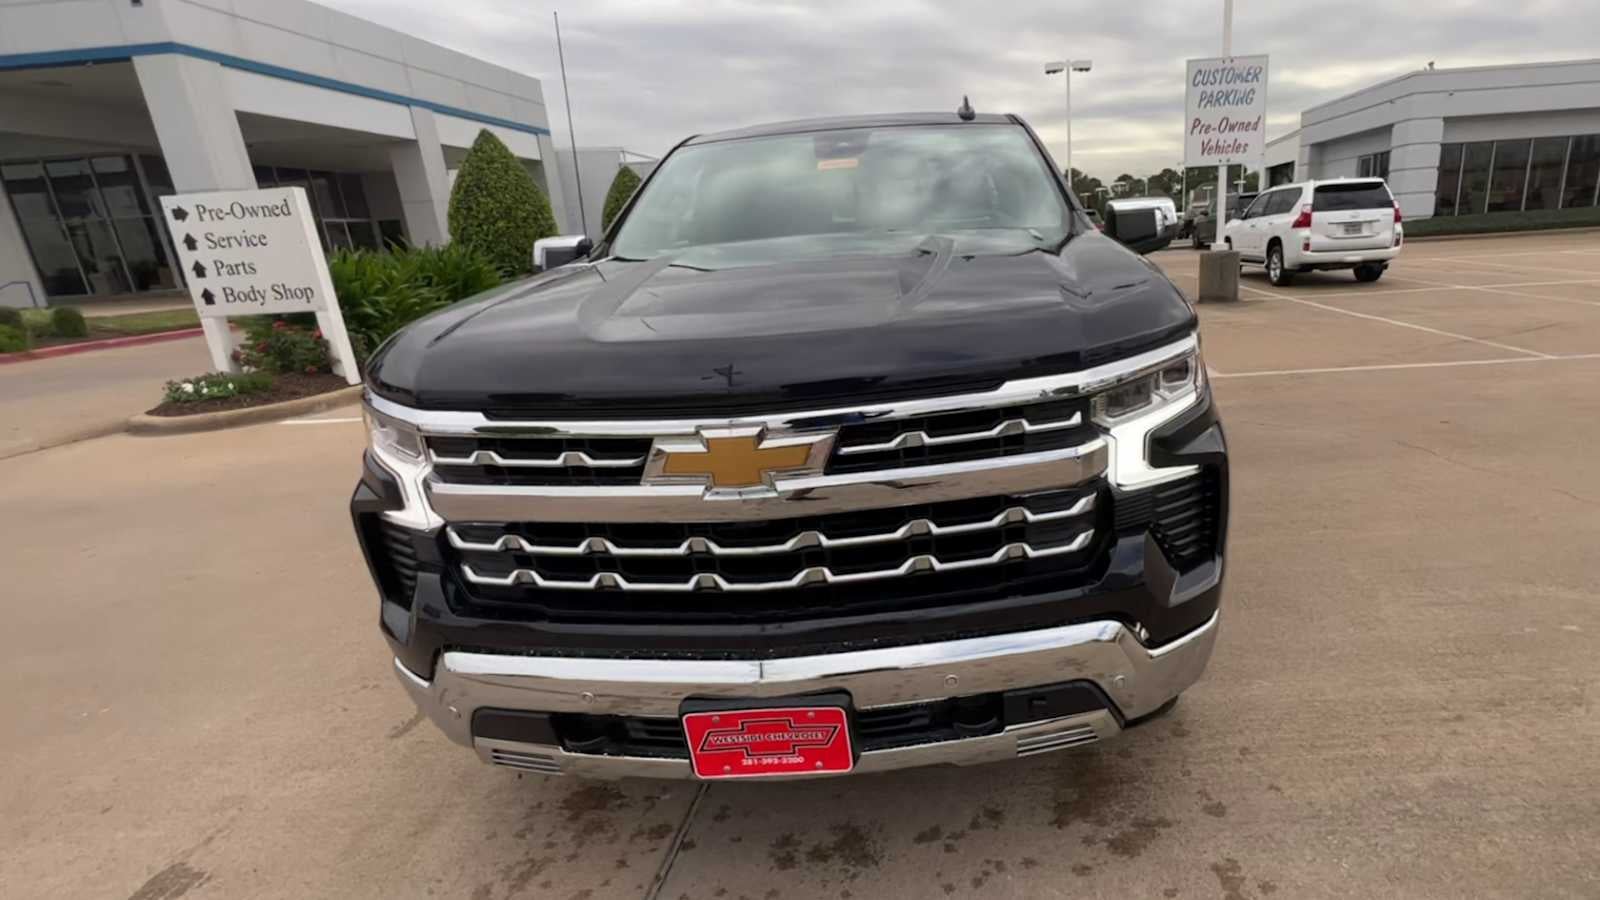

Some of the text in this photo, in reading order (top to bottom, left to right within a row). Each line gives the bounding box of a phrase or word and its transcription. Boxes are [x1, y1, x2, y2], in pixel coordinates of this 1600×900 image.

[1192, 65, 1263, 87] CUSTOMER
[1198, 88, 1256, 109] PARKING
[1190, 114, 1262, 136] Pre-Owned
[1200, 137, 1249, 156] Vehicles
[195, 198, 292, 222] Pre-Owned
[204, 229, 268, 249] Service
[213, 259, 257, 277] Parts
[222, 283, 315, 306] Body Shop
[710, 733, 763, 745] WESTSIDE
